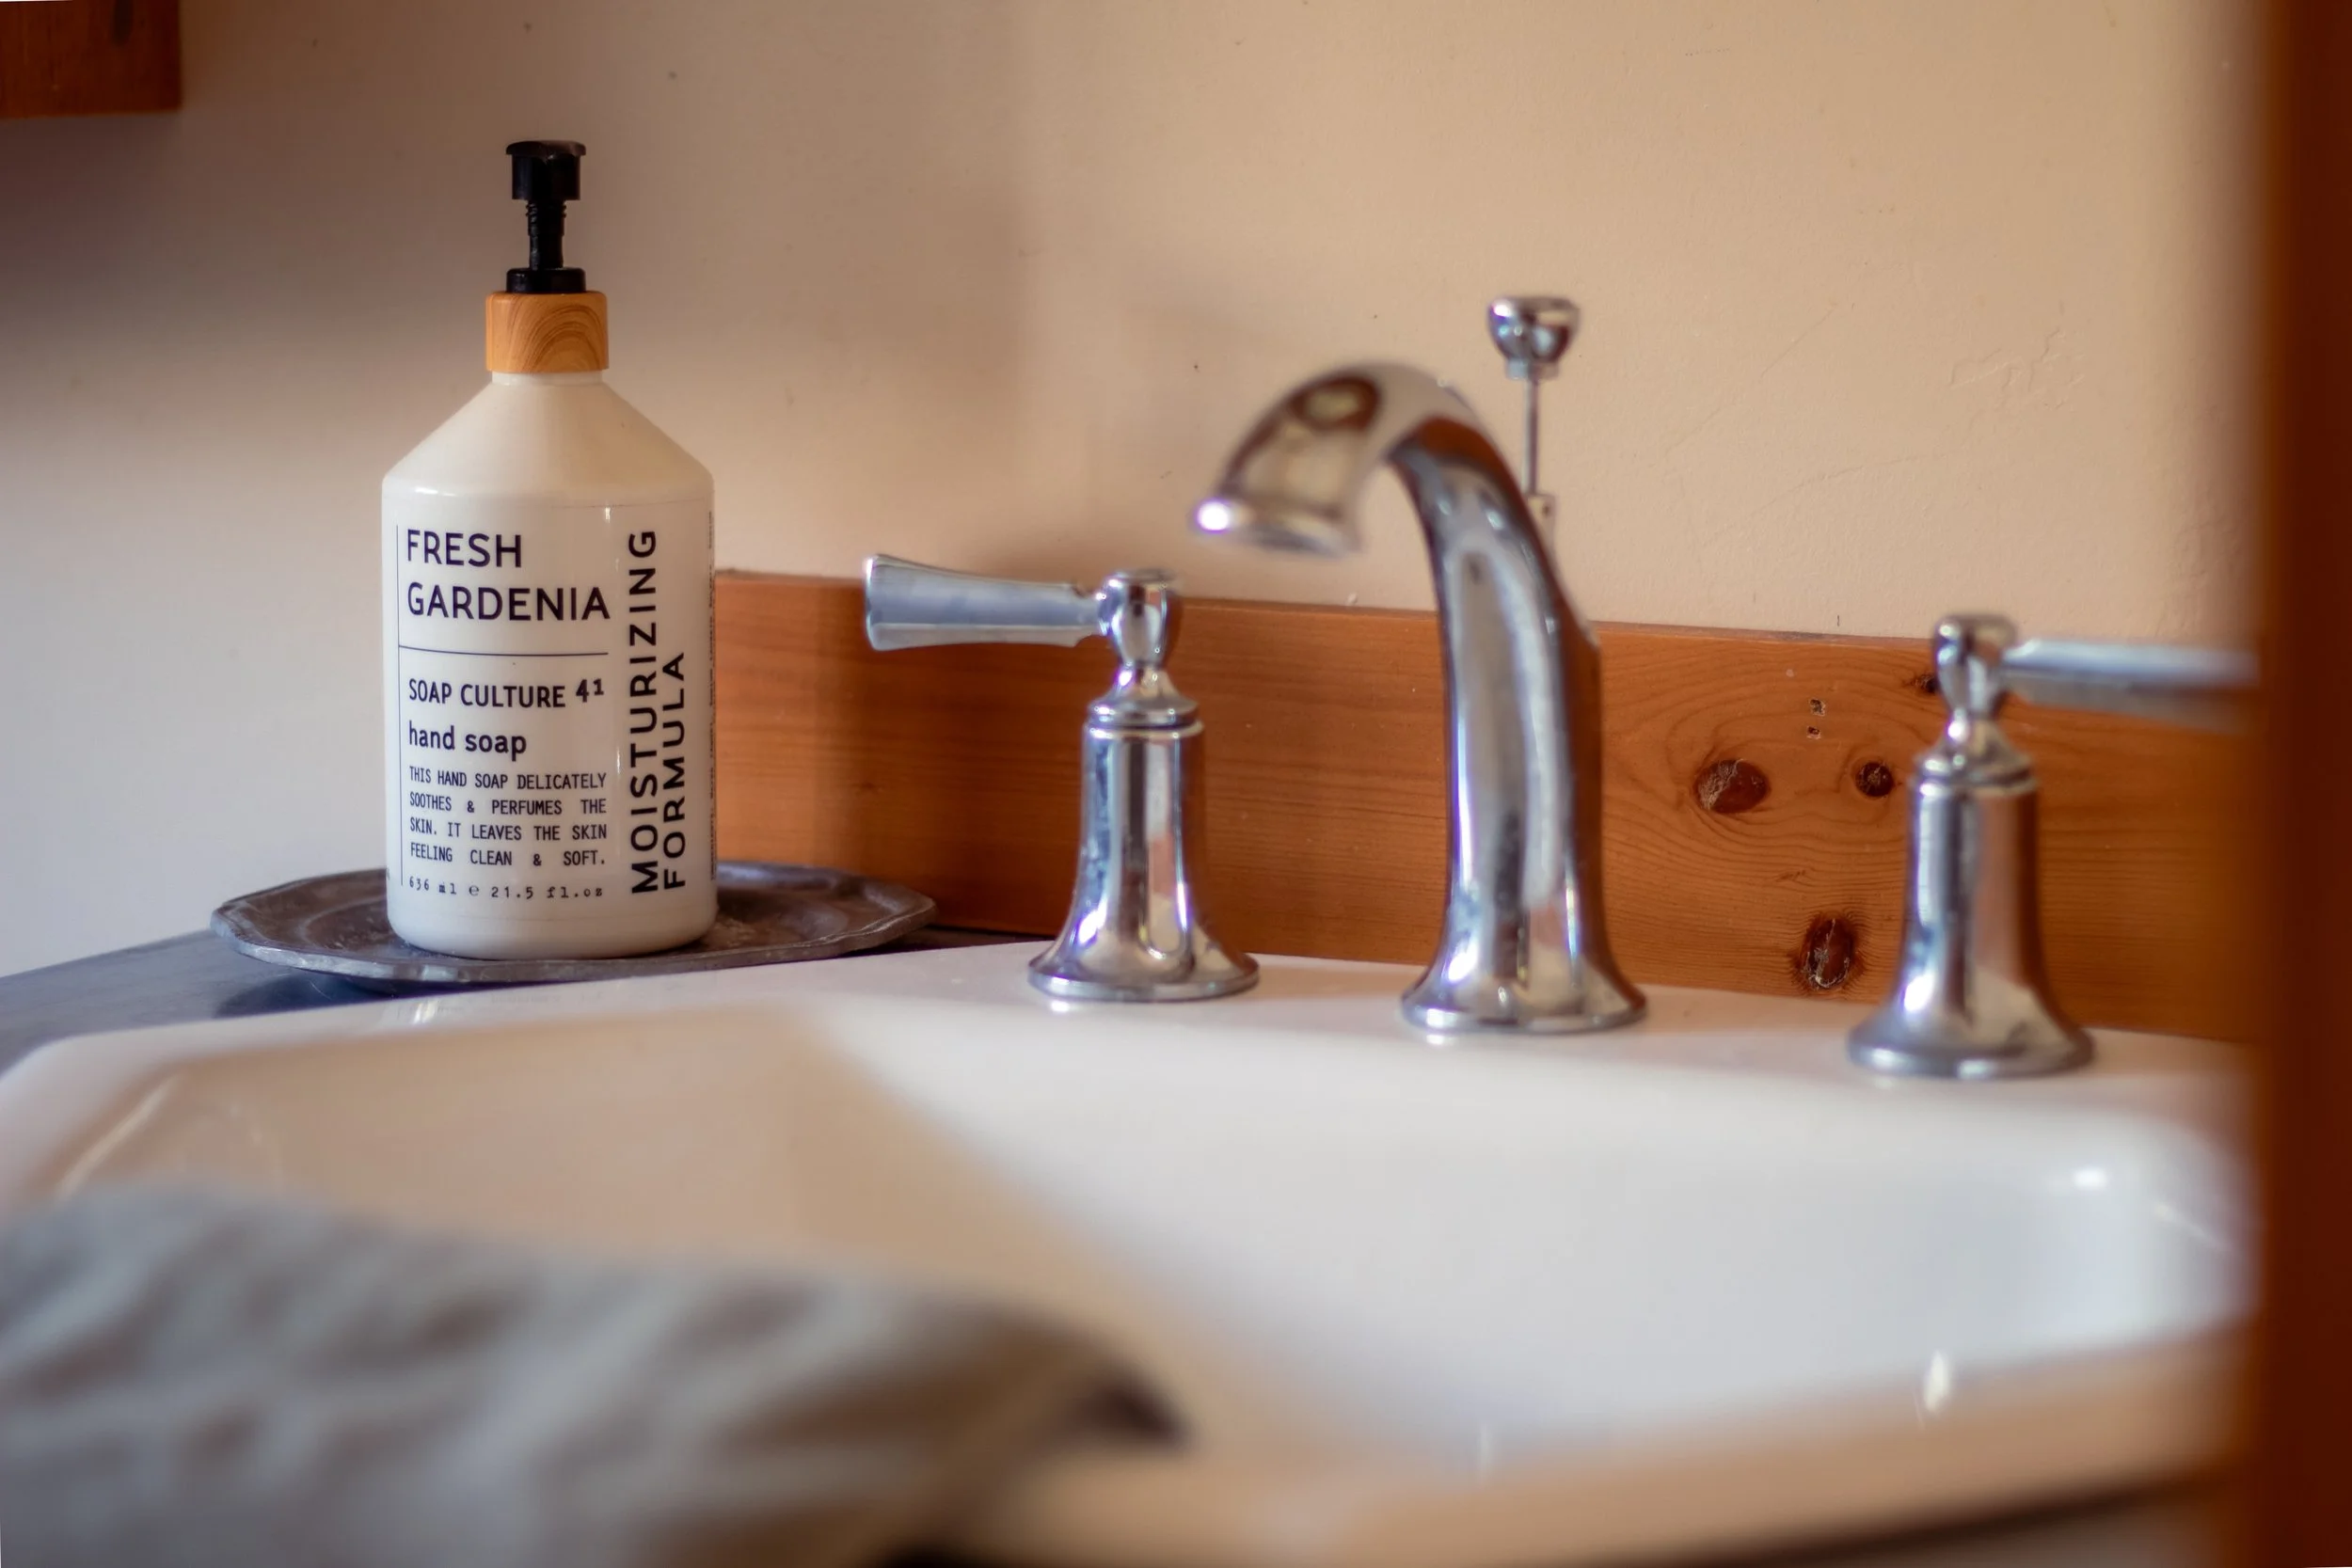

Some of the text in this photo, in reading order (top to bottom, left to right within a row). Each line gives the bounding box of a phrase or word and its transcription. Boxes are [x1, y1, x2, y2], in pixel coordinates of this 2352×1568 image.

[407, 528, 522, 568] FRESH
[407, 581, 611, 622] GARDENIA
[408, 677, 453, 705] SOAP
[460, 683, 566, 708] CULTURE
[628, 531, 659, 895] MOISTURIZING
[408, 720, 527, 763] hand soap
[408, 765, 607, 790] THIS HAND SOAP DELICATELY
[661, 652, 686, 891] FORMULA
[409, 791, 607, 816] SOOTHES & PERFUMES THE
[409, 816, 608, 841] SKIN. IT LEAVES THE SKIN
[410, 842, 605, 867] FEELING CLEAN & SOFT.
[408, 876, 430, 892] 636
[490, 886, 533, 900] 21.5
